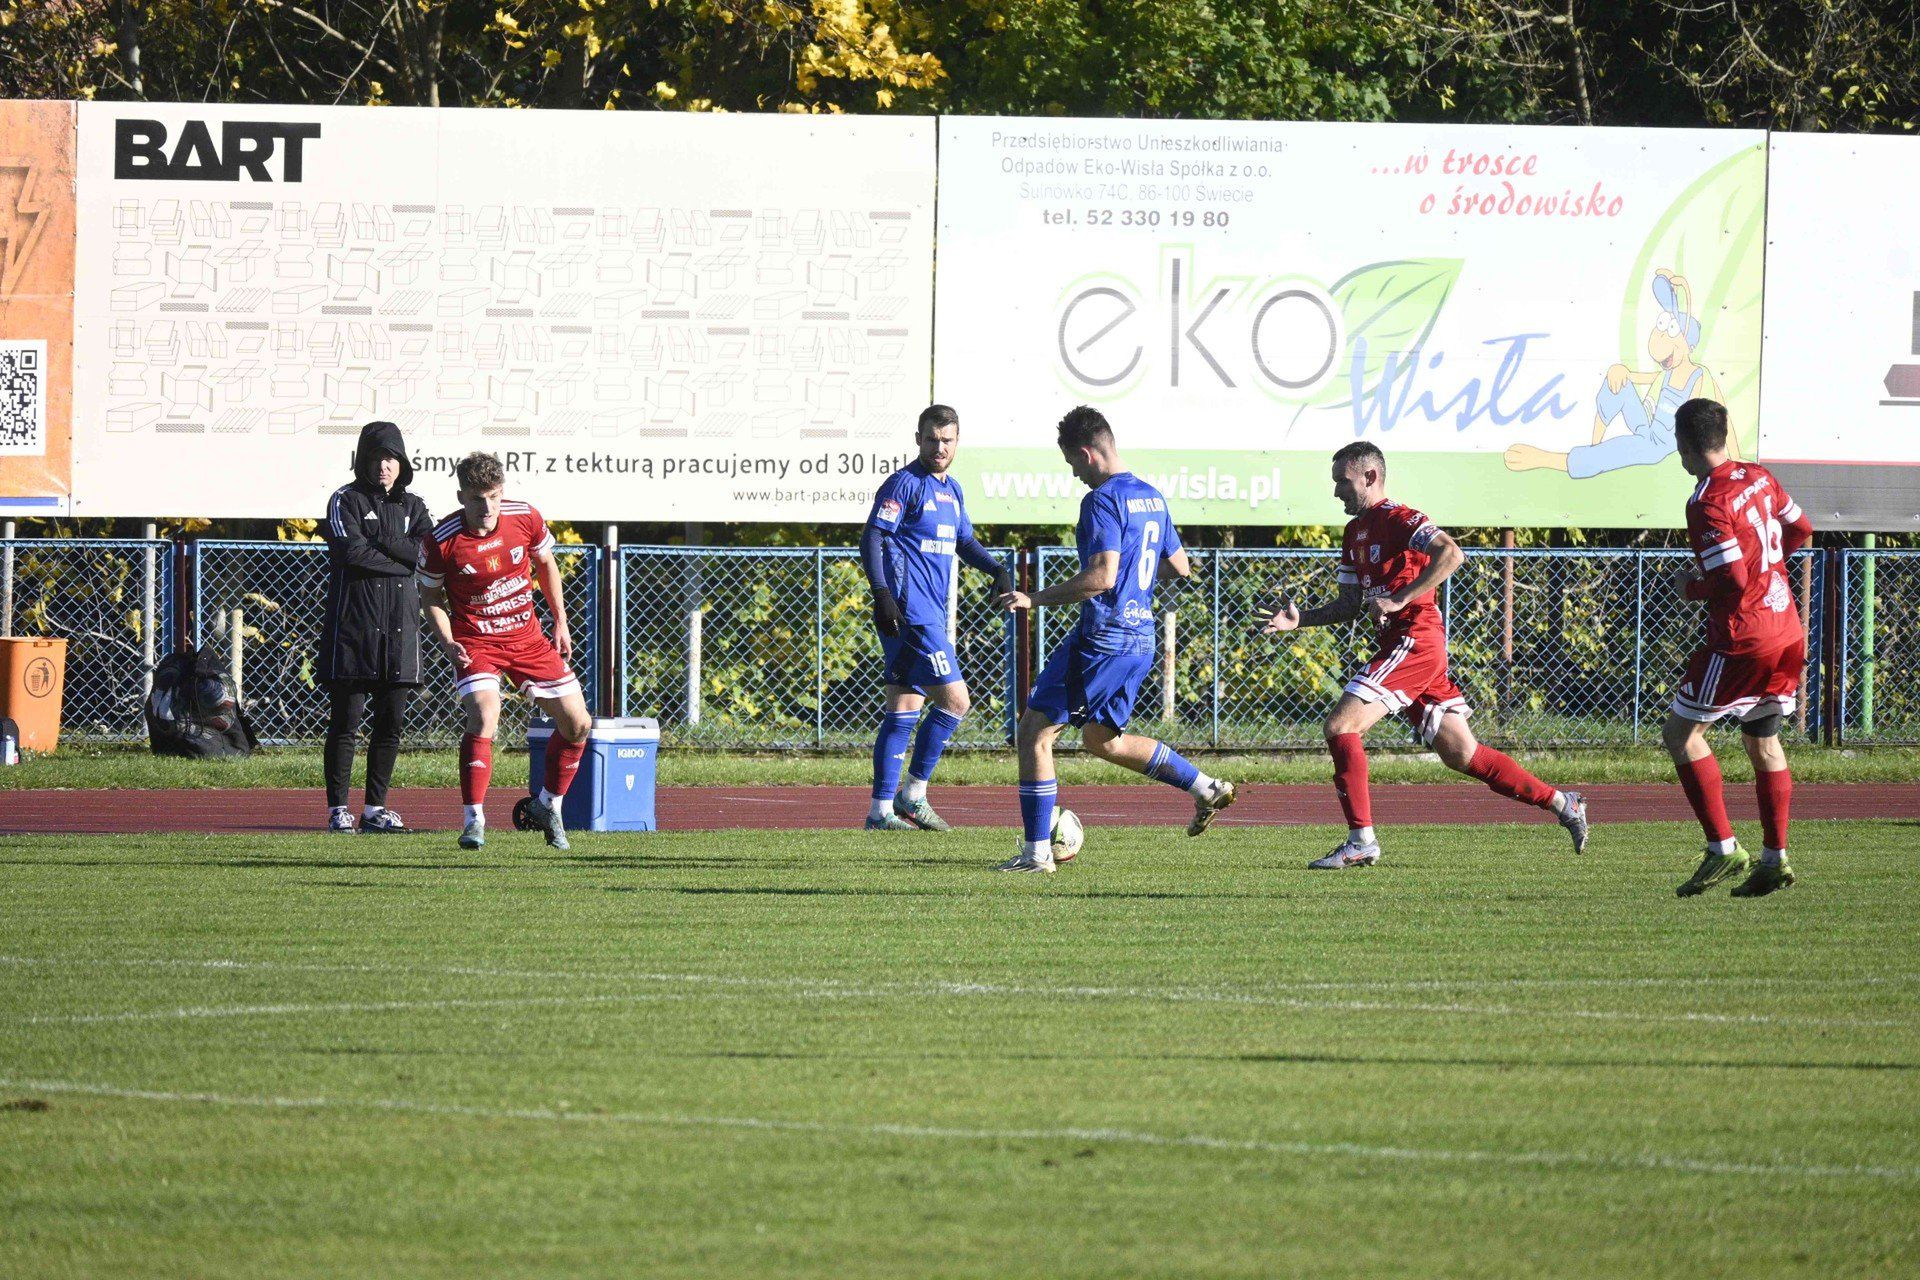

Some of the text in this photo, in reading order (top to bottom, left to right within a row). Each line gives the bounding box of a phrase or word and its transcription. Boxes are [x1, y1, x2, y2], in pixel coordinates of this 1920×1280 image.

[114, 118, 321, 183] BART
[992, 132, 1283, 153] Przedsiębiorstwo Unieszkodliwiania
[1001, 157, 1273, 180] Odpadów Eko-Wisła Spółka z o.o.
[1442, 149, 1538, 176] trosce
[1419, 181, 1624, 217] o środowisko
[1042, 209, 1230, 228] tel. 52 330 19 80
[1057, 257, 1338, 389] eko
[545, 458, 557, 473] z
[565, 452, 653, 479] tekturą
[663, 453, 790, 479] pracujemy
[800, 453, 828, 474] od
[838, 453, 864, 474] 30
[1138, 520, 1160, 591] 6
[927, 650, 951, 678] 16
